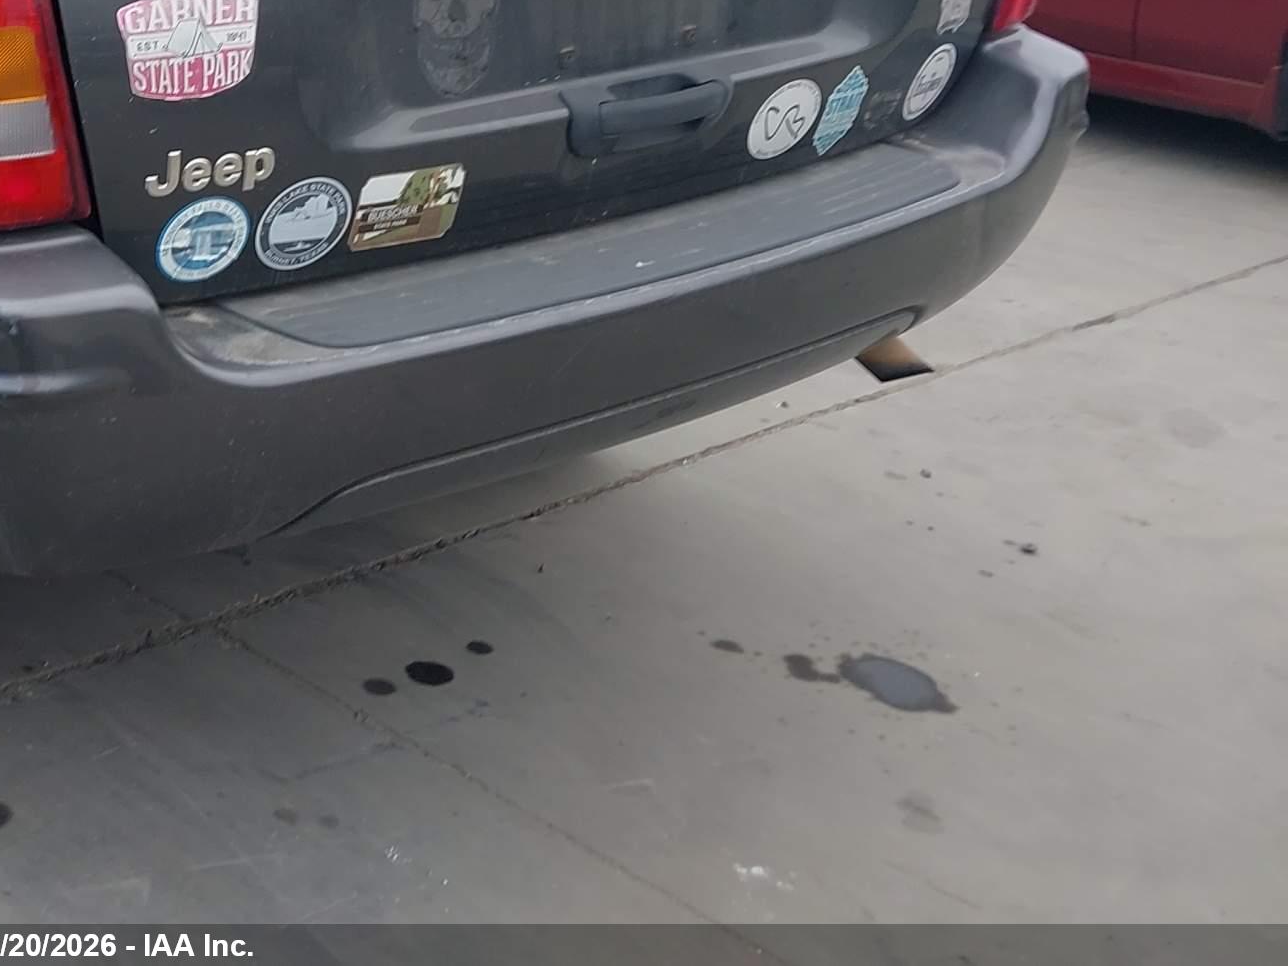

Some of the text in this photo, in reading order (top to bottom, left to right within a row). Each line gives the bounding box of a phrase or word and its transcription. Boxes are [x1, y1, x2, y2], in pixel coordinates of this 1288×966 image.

[132, 49, 253, 94] STATE PARK
[145, 147, 275, 197] Jeep
